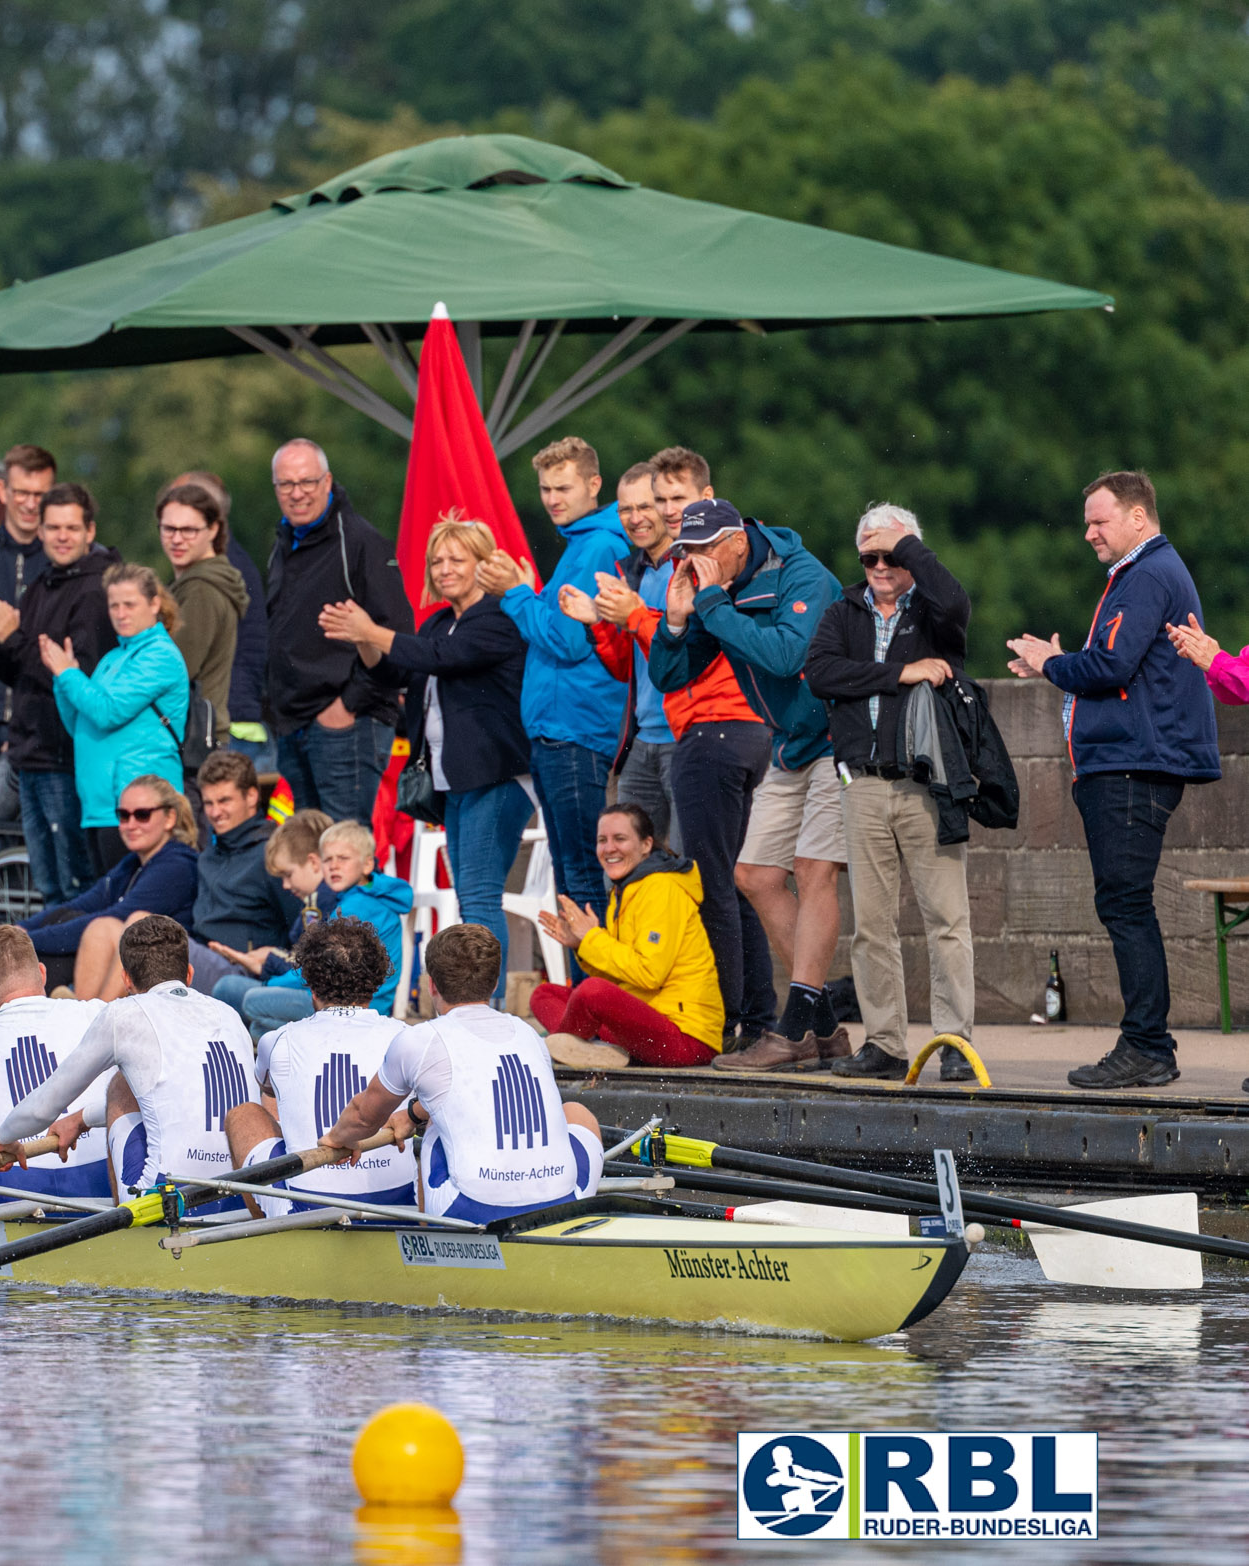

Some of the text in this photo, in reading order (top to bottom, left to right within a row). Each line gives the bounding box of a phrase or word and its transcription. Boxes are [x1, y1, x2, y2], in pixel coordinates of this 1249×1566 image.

[478, 1164, 565, 1182] Münster-Achter
[939, 1153, 955, 1213] 3
[411, 1236, 501, 1261] RBL RUDER-BUNDESLIGA
[663, 1248, 791, 1282] Münster-Achter
